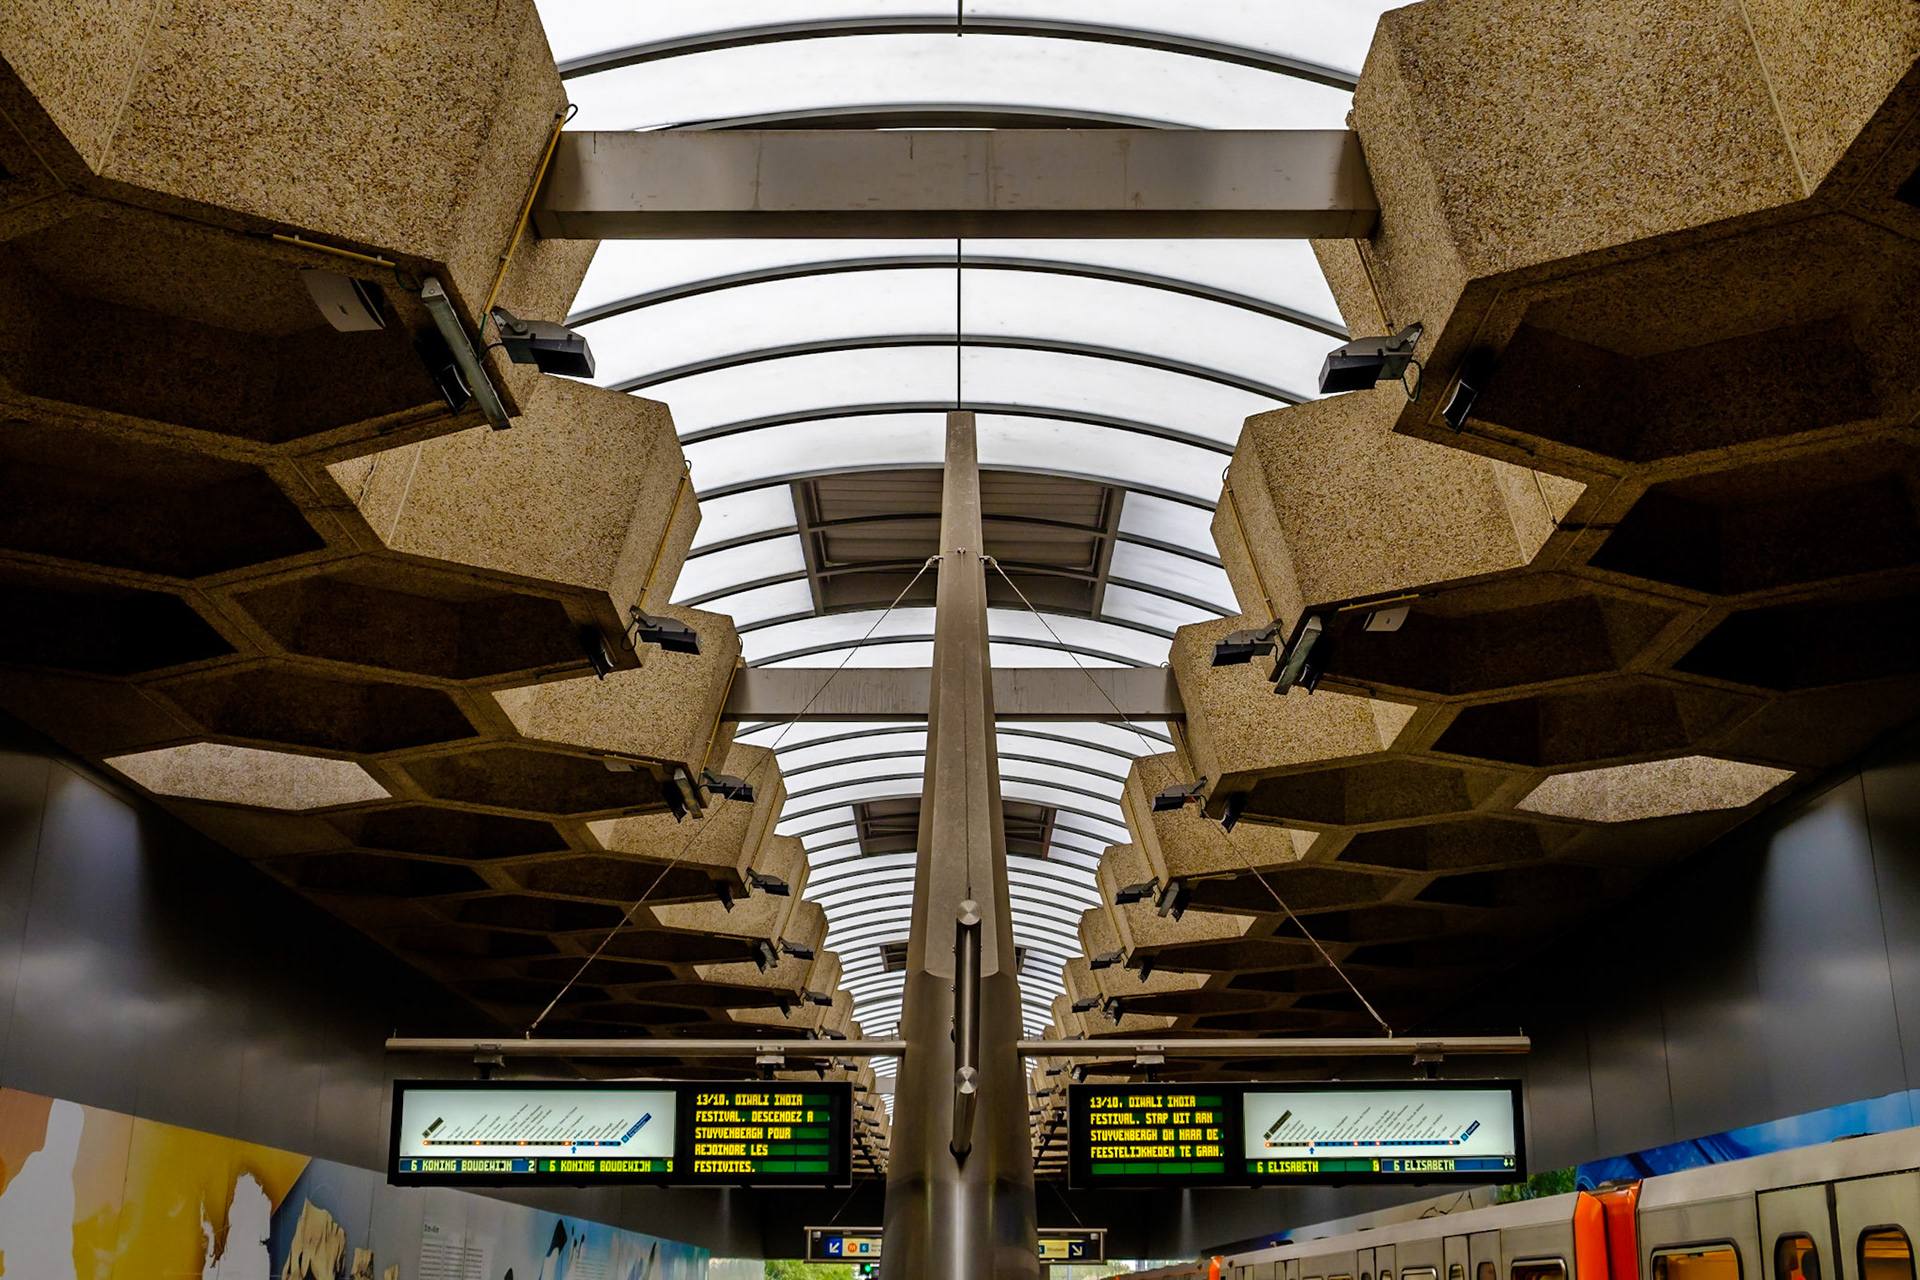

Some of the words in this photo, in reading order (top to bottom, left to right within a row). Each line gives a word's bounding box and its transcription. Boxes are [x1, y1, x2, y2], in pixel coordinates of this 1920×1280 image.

[735, 1094, 769, 1106] DIWALI
[774, 1094, 803, 1106] INDIA
[1128, 1095, 1162, 1107] DIWALI
[1167, 1095, 1196, 1107] INDIA
[696, 1111, 745, 1122] FESTIVAL.
[752, 1111, 802, 1122] DESCENDEZ
[807, 1110, 814, 1122] A
[1090, 1112, 1139, 1124] FESTIVAL.
[1145, 1112, 1168, 1124] STAP
[1173, 1112, 1190, 1124] UIT
[1195, 1112, 1213, 1123] AAN
[695, 1127, 763, 1139] STUYVENBERGH
[768, 1127, 791, 1139] POUR
[1090, 1129, 1158, 1141] STUYVENBERGH
[1179, 1129, 1202, 1140] NAAR
[1206, 1129, 1219, 1140] DE
[695, 1144, 746, 1156] REJOINDRE
[751, 1144, 768, 1156] LES
[1090, 1146, 1175, 1158] FEESTELIJKHEDEN
[1179, 1145, 1191, 1157] TE
[1196, 1145, 1223, 1157] GAAN.
[411, 1160, 418, 1171] 6
[422, 1160, 456, 1171] KONING
[461, 1160, 512, 1172] BOUDEWIJN
[528, 1160, 535, 1171] 2
[549, 1161, 556, 1172] 6
[560, 1161, 595, 1172] KONING
[600, 1161, 651, 1172] BOUDEWIJN
[666, 1161, 673, 1172] 9
[694, 1161, 755, 1173] FESTIVITES.
[1257, 1161, 1263, 1173] 6
[1268, 1161, 1319, 1173] ELISABETH
[1372, 1160, 1380, 1172] 8
[1393, 1160, 1400, 1171] 6
[1404, 1160, 1455, 1171] ELISABETH
